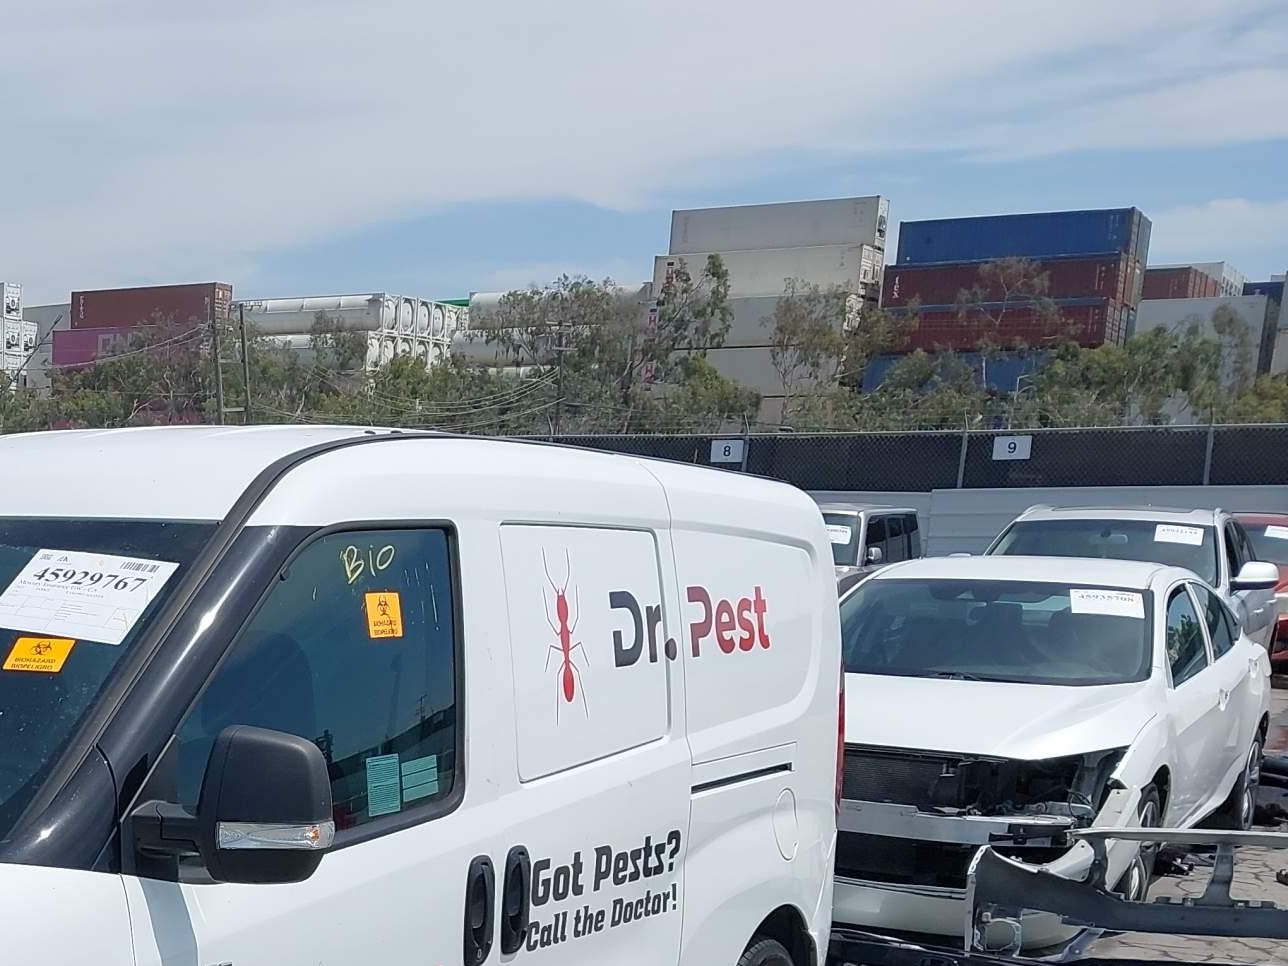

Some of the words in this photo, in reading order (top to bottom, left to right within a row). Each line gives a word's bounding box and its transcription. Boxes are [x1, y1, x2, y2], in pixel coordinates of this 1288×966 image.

[723, 445, 732, 457] 8
[1007, 441, 1017, 454] 9
[33, 567, 147, 592] 45929767
[609, 590, 677, 667] Dr.
[686, 586, 771, 658] Pest
[531, 851, 584, 907] Got
[593, 830, 681, 892] Pests?
[526, 911, 568, 952] Call
[573, 905, 606, 938] the
[610, 883, 677, 928] Doctor!
